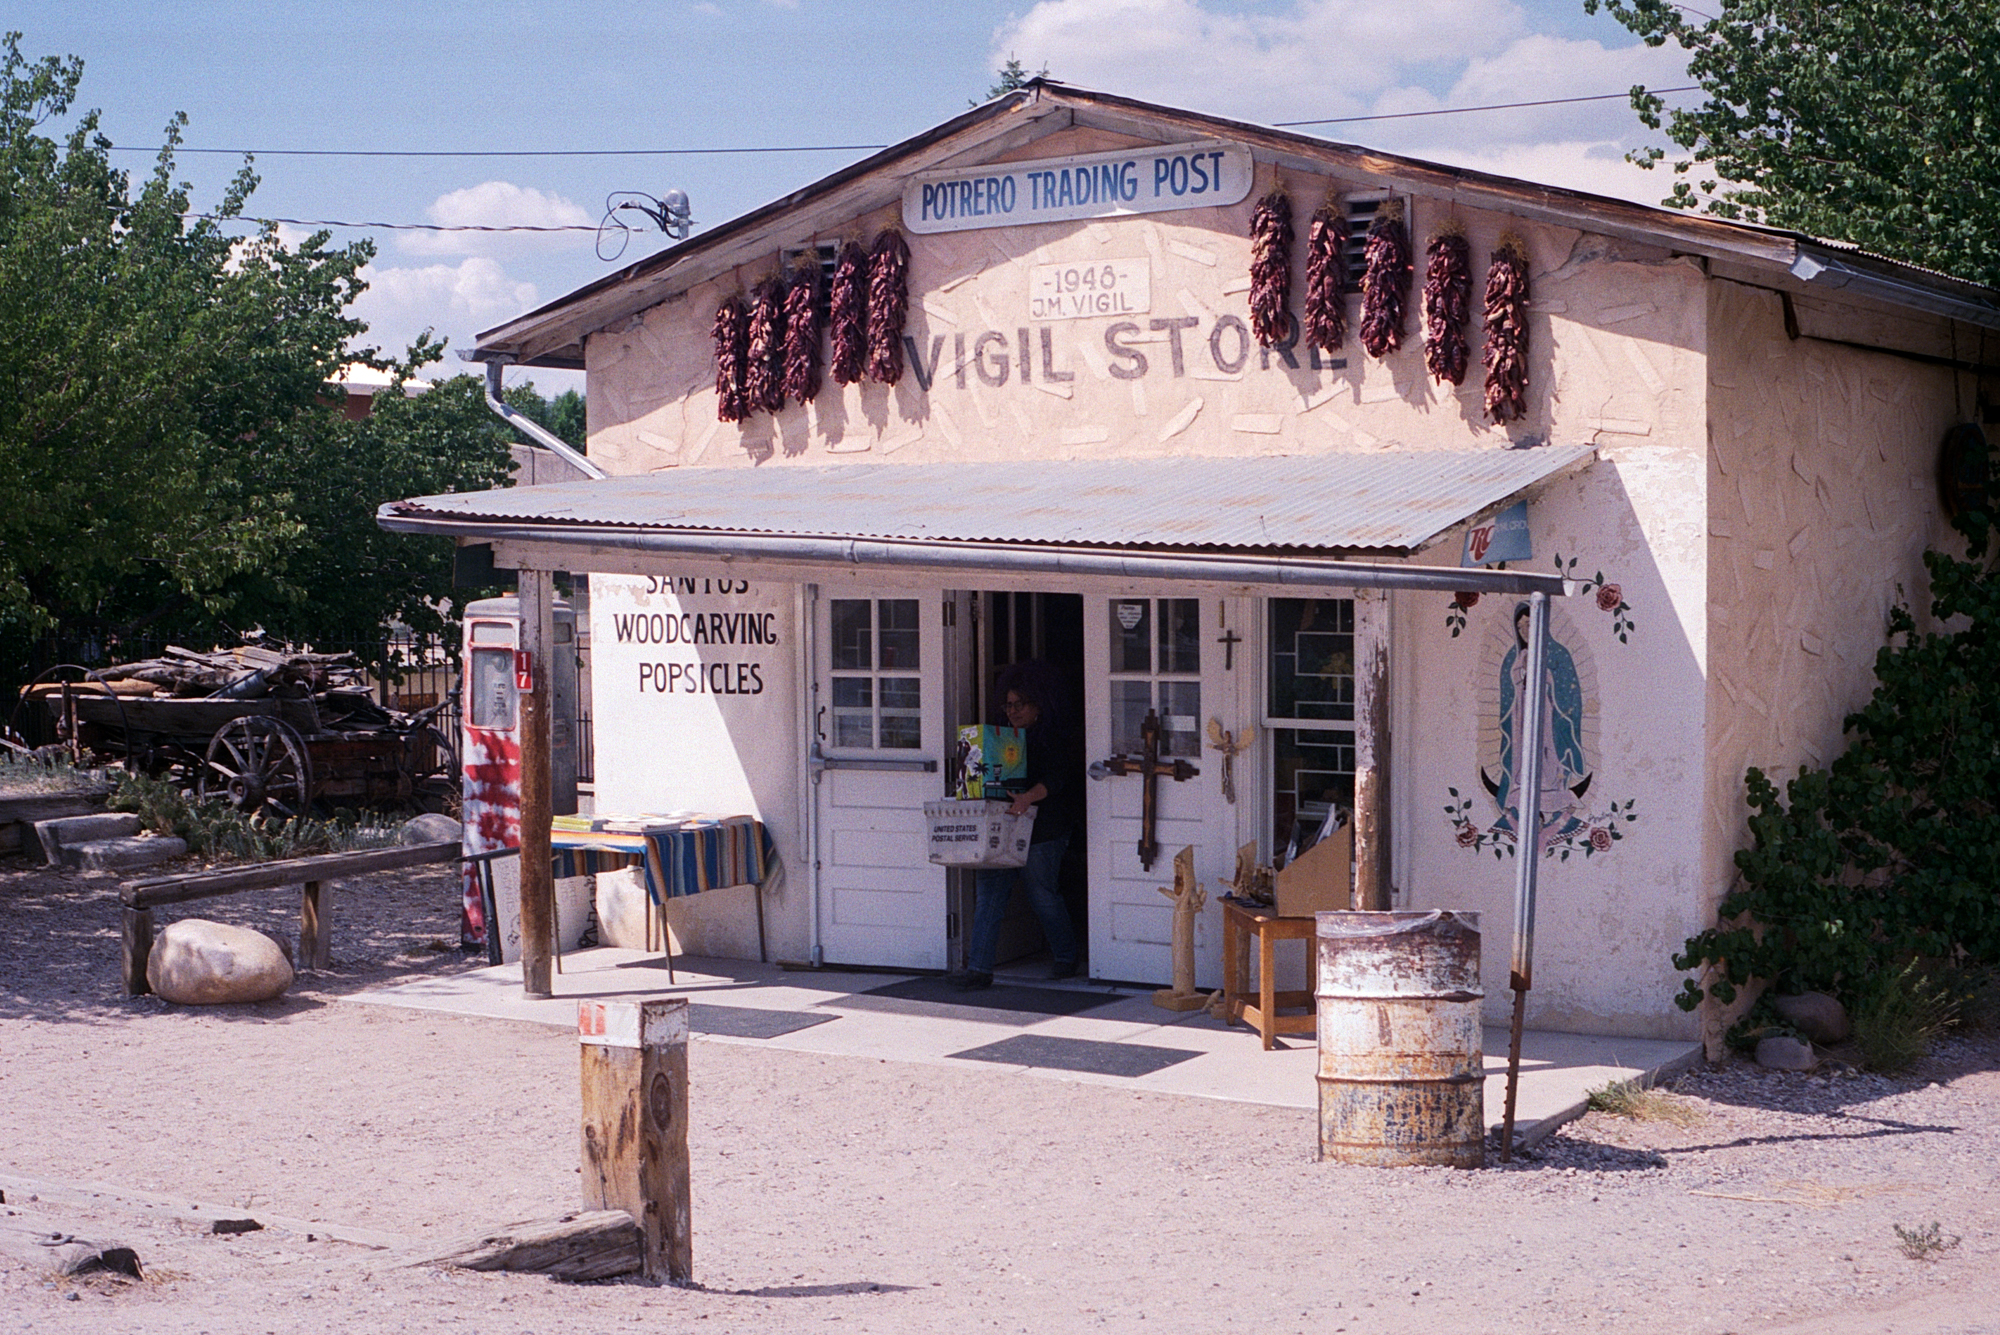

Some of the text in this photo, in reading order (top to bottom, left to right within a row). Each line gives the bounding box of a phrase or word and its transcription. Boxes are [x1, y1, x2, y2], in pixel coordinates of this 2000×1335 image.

[921, 151, 1225, 221] POTRERO TRADING POST
[1033, 291, 1133, 318] J.M. VIGIL
[903, 326, 1075, 392] VIGIL
[1468, 524, 1496, 561] RC
[639, 662, 764, 695] POPSICLES
[931, 833, 979, 843] POSTAL SERVICE
[933, 824, 977, 833] UNITED STATES
